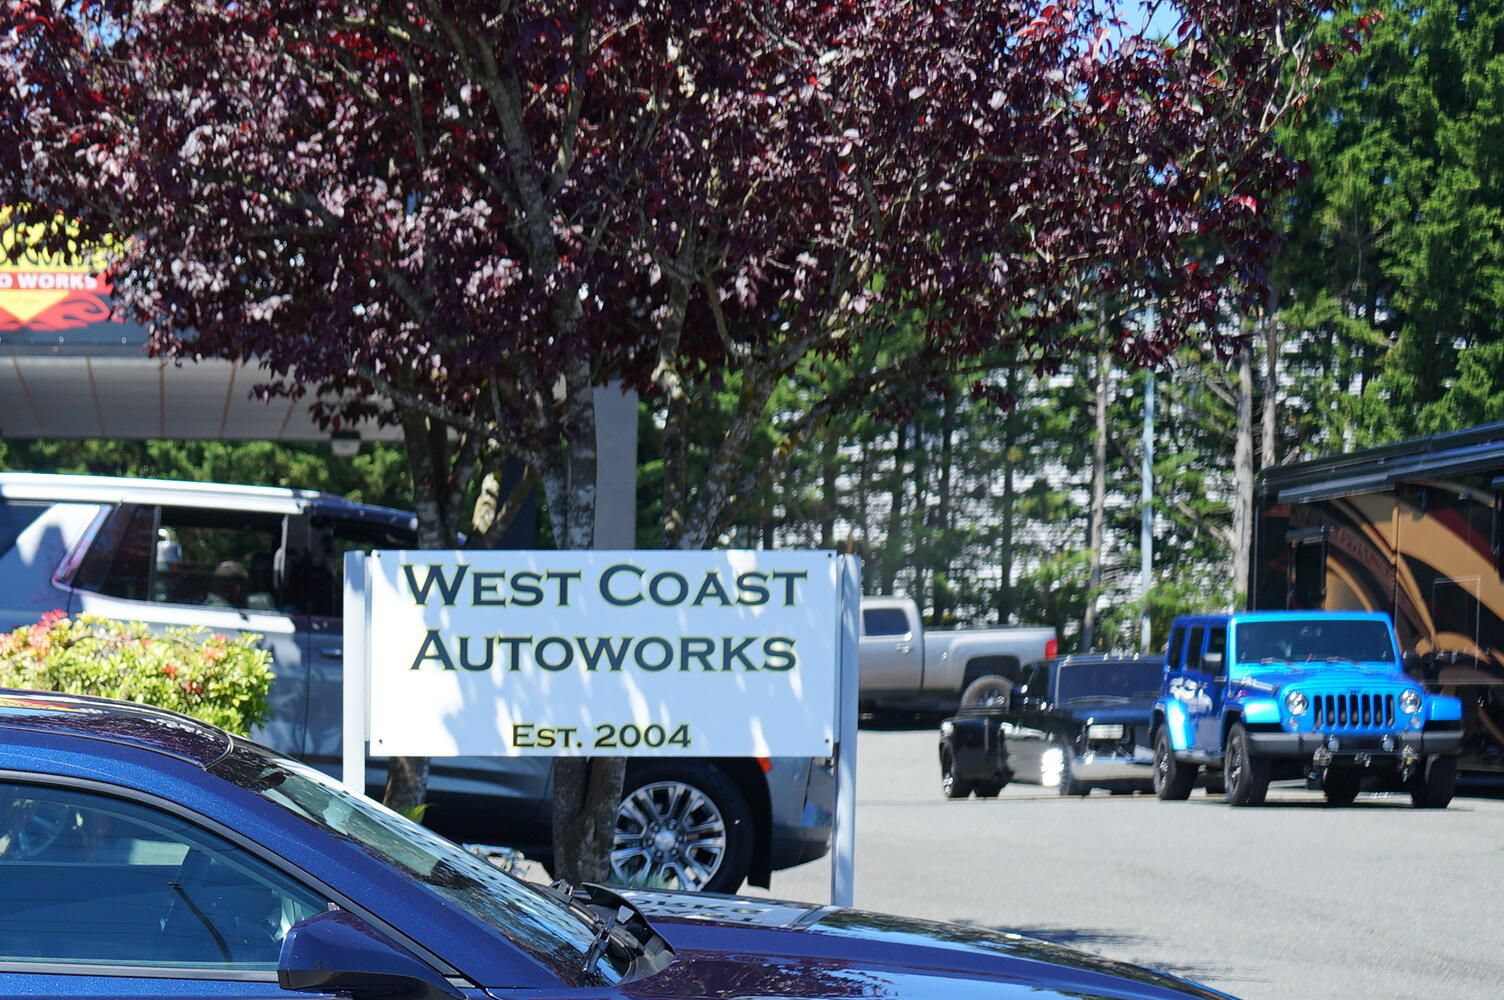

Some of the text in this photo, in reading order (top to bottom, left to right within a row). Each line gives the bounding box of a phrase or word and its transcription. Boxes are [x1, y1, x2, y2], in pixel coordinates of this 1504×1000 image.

[18, 273, 98, 290] WORKS
[402, 563, 808, 607] WEST COAST
[410, 629, 798, 673] AUTOWORKS
[512, 723, 692, 749] EST. 2004
